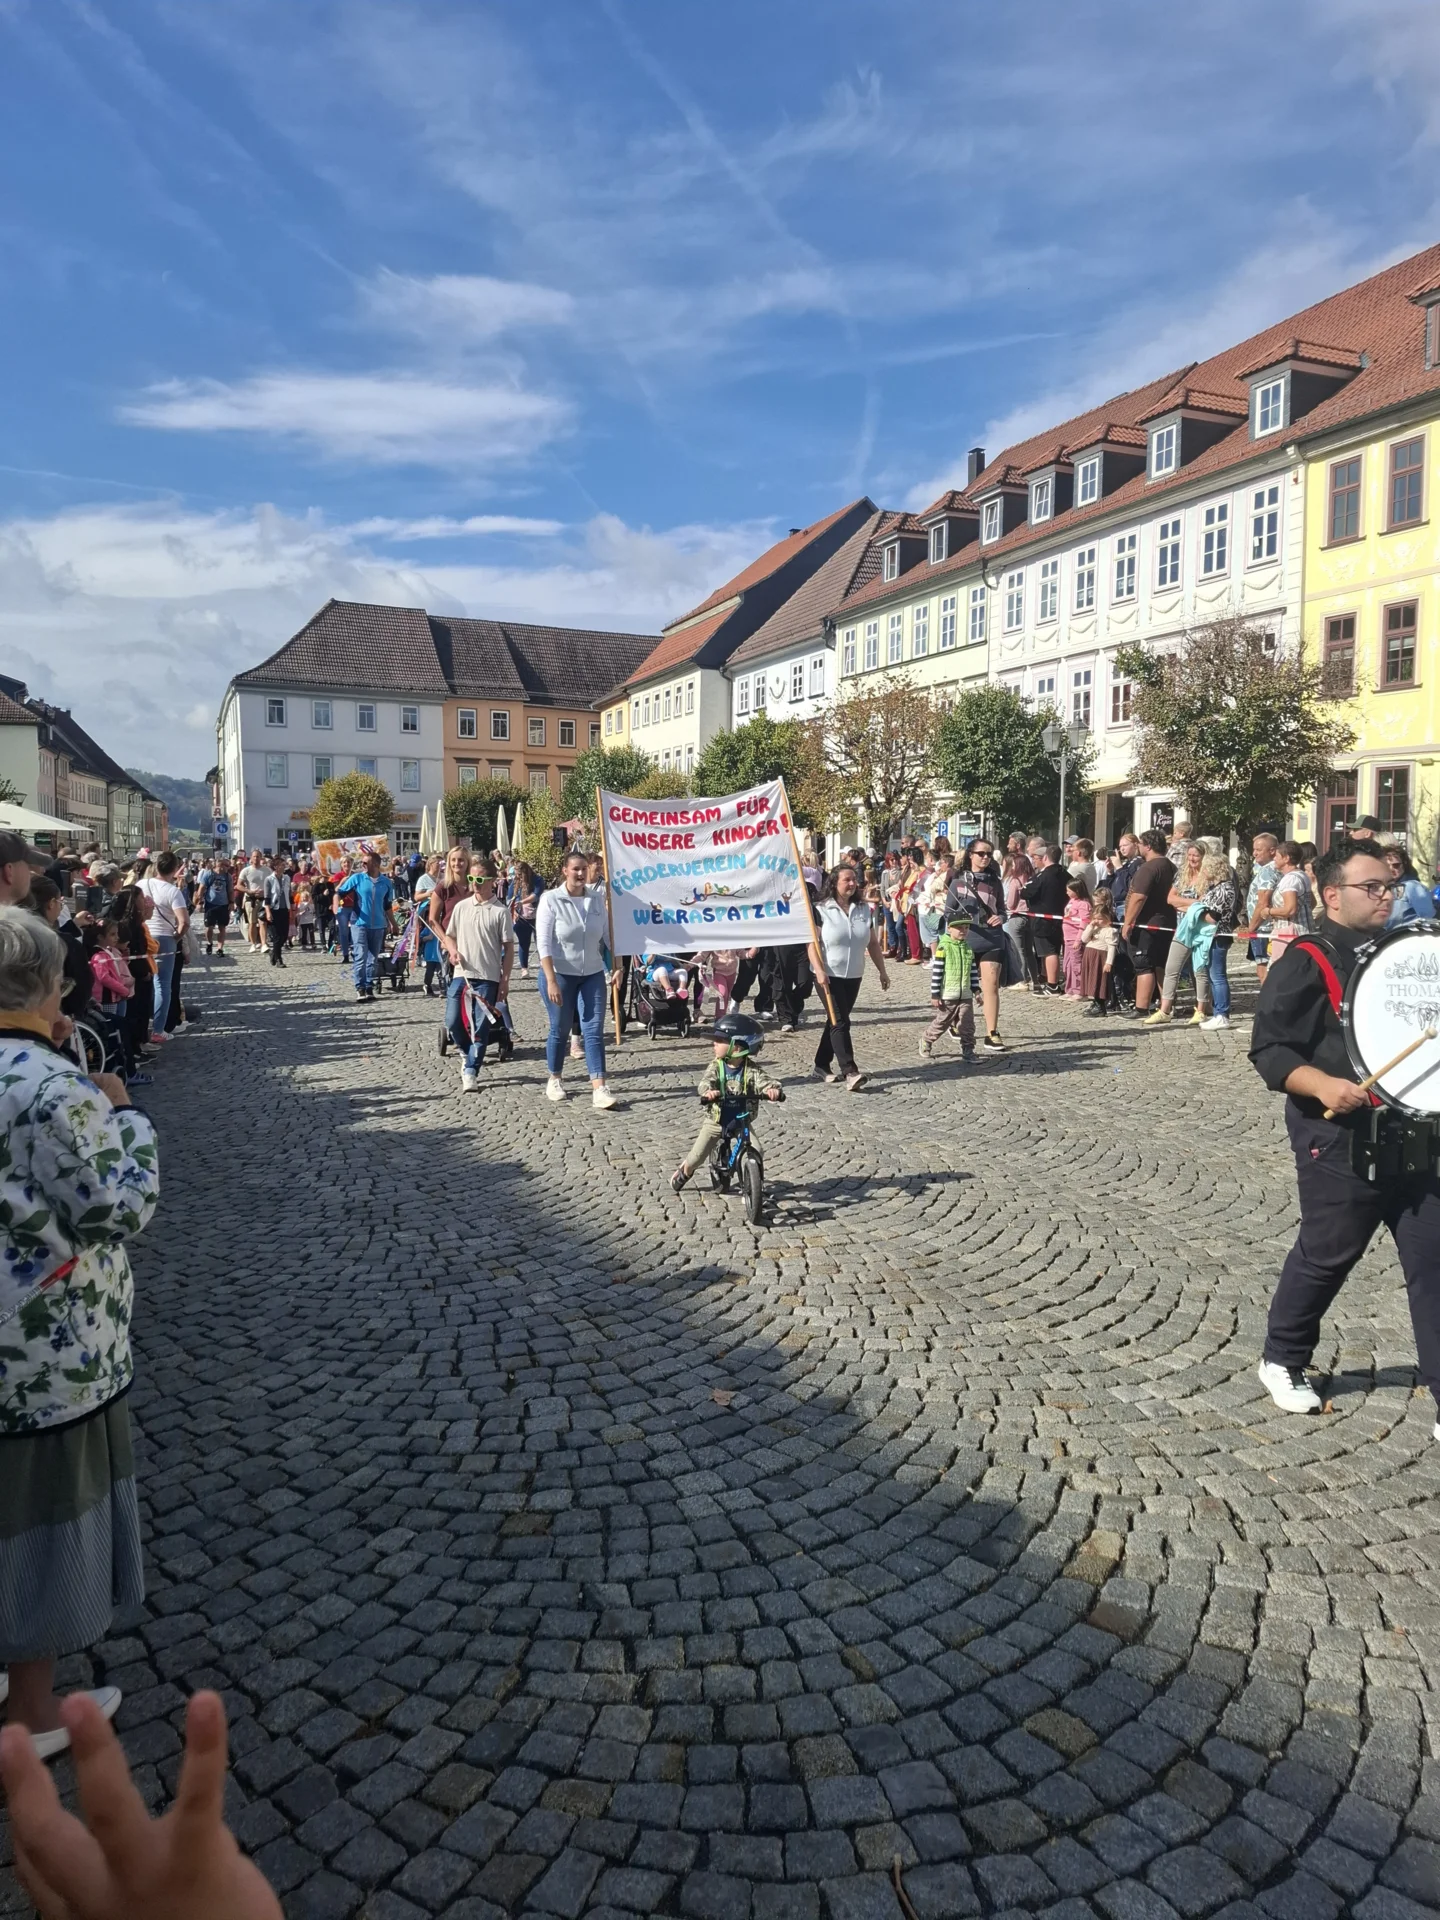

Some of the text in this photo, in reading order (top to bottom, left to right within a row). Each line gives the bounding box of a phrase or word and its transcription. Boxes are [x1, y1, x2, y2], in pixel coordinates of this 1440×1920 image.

[609, 796, 770, 825] GEMEINSAM FÜR
[621, 813, 789, 850] UNSERE KINDER!
[611, 854, 798, 896] FÖRDERVEREIN KITA
[633, 900, 790, 925] WERRASPATZEN
